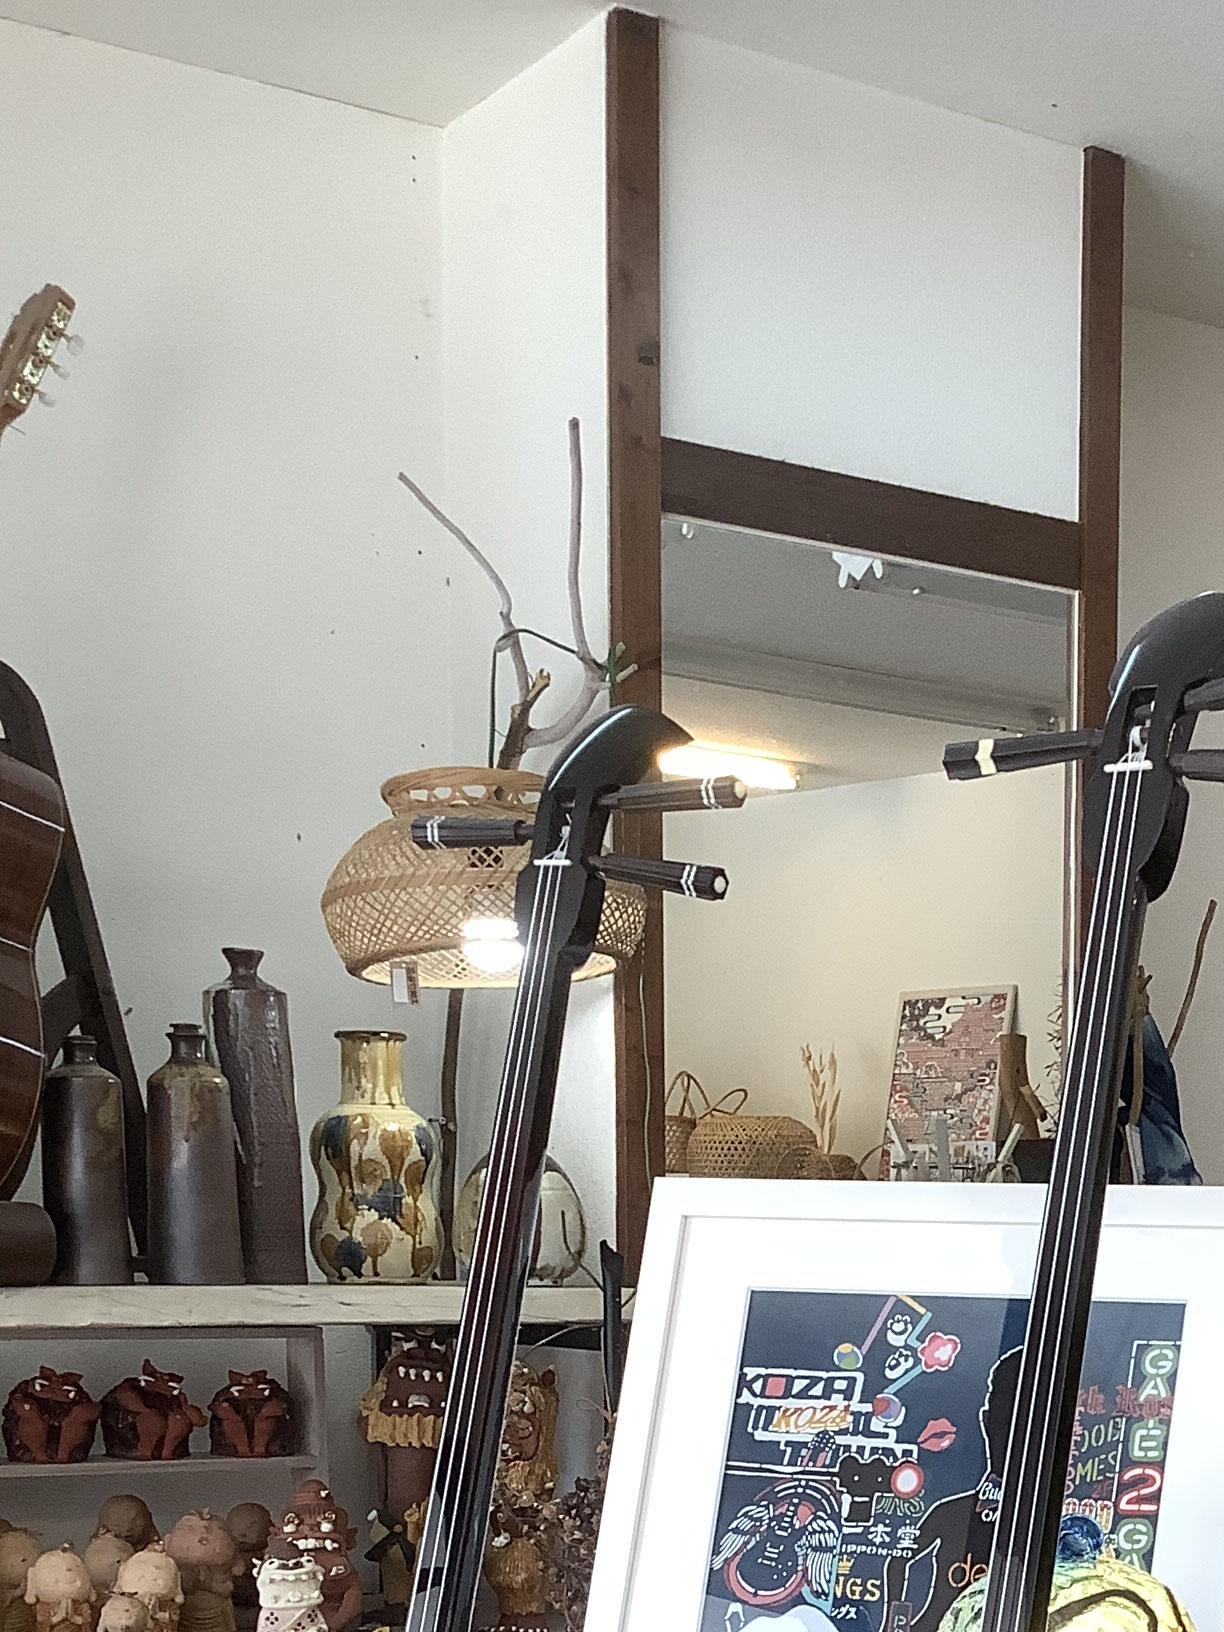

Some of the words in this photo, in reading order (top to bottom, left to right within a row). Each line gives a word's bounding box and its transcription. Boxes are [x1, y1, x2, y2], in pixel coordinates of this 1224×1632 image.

[737, 1373, 857, 1401] KOZA
[772, 1404, 851, 1432] KOZA
[1119, 1468, 1162, 1511] 2
[842, 1523, 920, 1549] 一本堂
